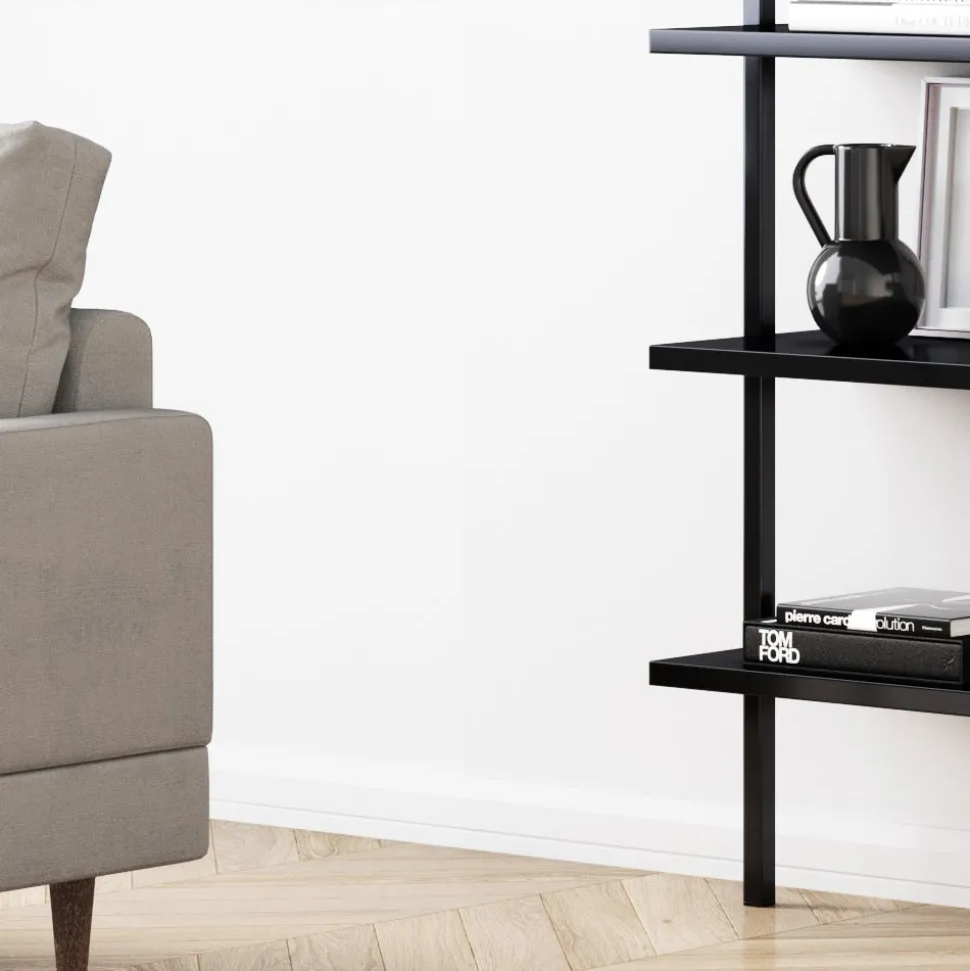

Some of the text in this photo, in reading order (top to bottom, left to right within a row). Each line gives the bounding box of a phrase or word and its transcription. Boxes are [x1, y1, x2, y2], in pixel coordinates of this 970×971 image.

[785, 609, 821, 624] pierre
[823, 613, 851, 627] card
[875, 617, 915, 631] olution
[758, 629, 793, 648] TOM
[759, 645, 800, 664] FORD
